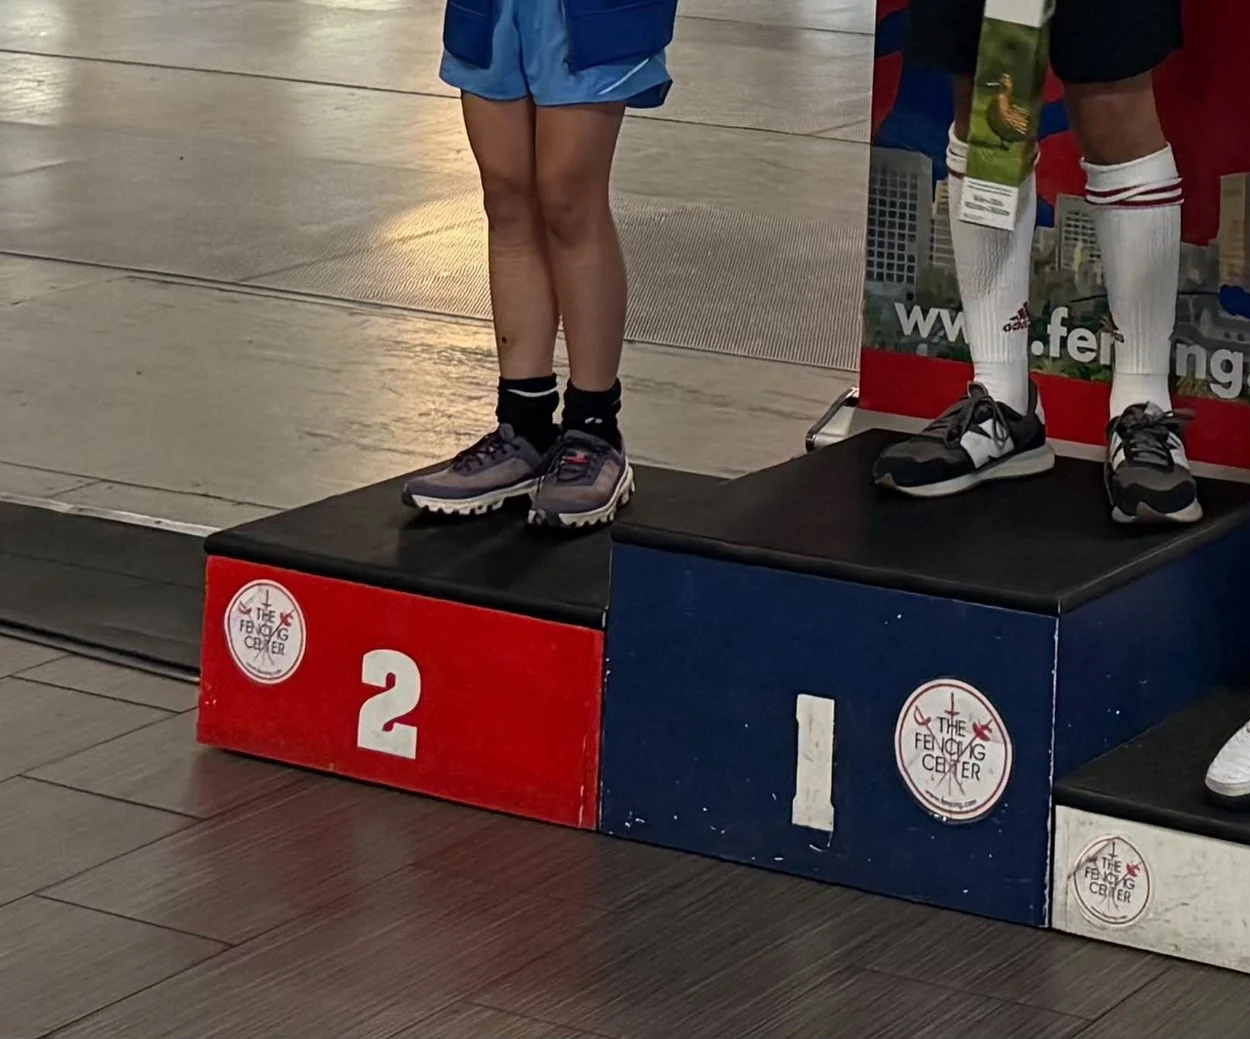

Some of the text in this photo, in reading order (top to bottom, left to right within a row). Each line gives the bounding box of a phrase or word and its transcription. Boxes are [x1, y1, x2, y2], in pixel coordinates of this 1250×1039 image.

[357, 648, 421, 760] 2
[936, 716, 967, 738] THE
[1101, 856, 1122, 874] THE
